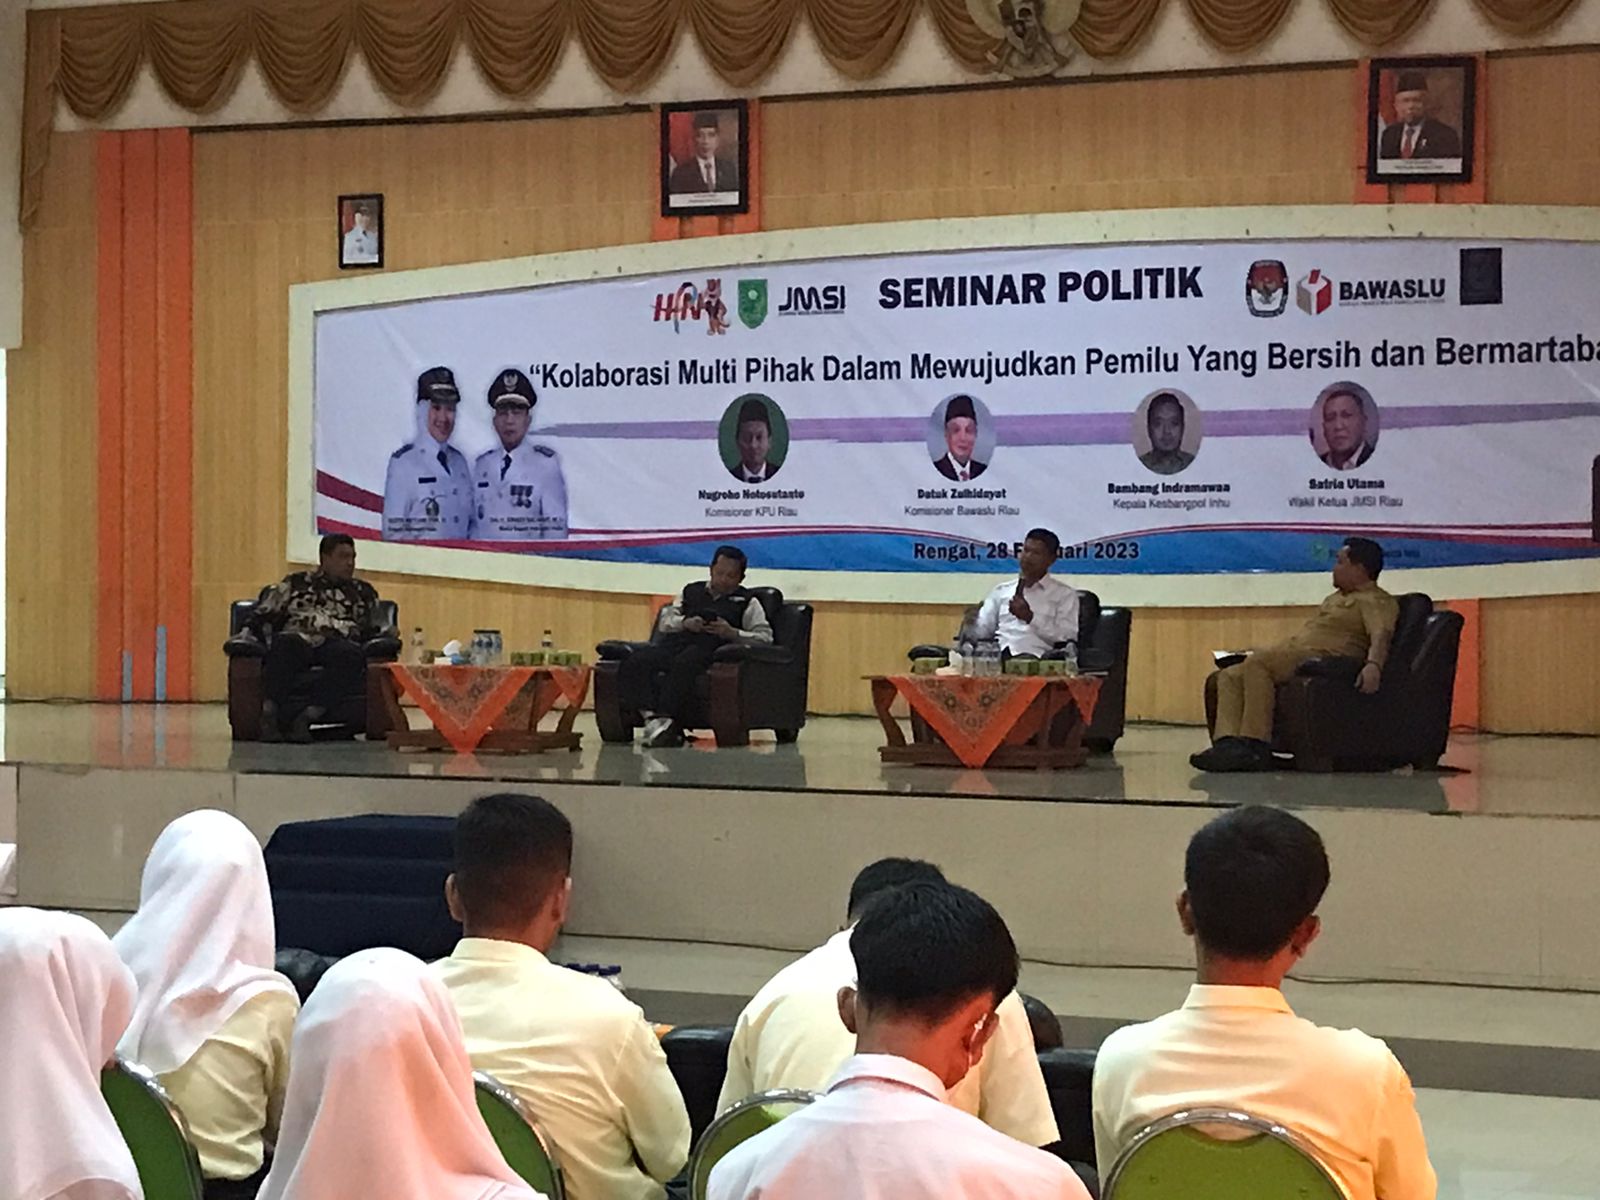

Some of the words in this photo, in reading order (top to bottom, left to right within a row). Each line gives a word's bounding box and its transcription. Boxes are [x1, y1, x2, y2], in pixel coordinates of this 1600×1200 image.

[878, 273, 1046, 309] SEMINAR
[1058, 266, 1203, 302] POLITIK
[1339, 278, 1446, 301] BAWASLU
[778, 285, 846, 312] JMSI
[678, 358, 737, 386] Multi
[745, 356, 815, 384] Pihak
[823, 354, 901, 381] Dalam
[911, 350, 1076, 385] Mewujudkan
[1086, 346, 1179, 374] Pemilu
[1187, 345, 1257, 378] Yang
[1268, 341, 1361, 370] Bersih
[1371, 339, 1425, 367] dan
[1436, 333, 1600, 365] Bermartab
[1107, 483, 1160, 495] Bambang
[1308, 478, 1345, 489] Satria
[1346, 478, 1385, 489] Utama
[755, 506, 775, 517] KPU
[778, 506, 798, 517] Riau
[957, 505, 996, 516] Bawaslu
[998, 504, 1020, 516] Riau
[1113, 499, 1147, 510] Kepala
[914, 542, 981, 562] Rengat,
[986, 541, 1008, 558] 28
[1094, 541, 1140, 559] 2023
